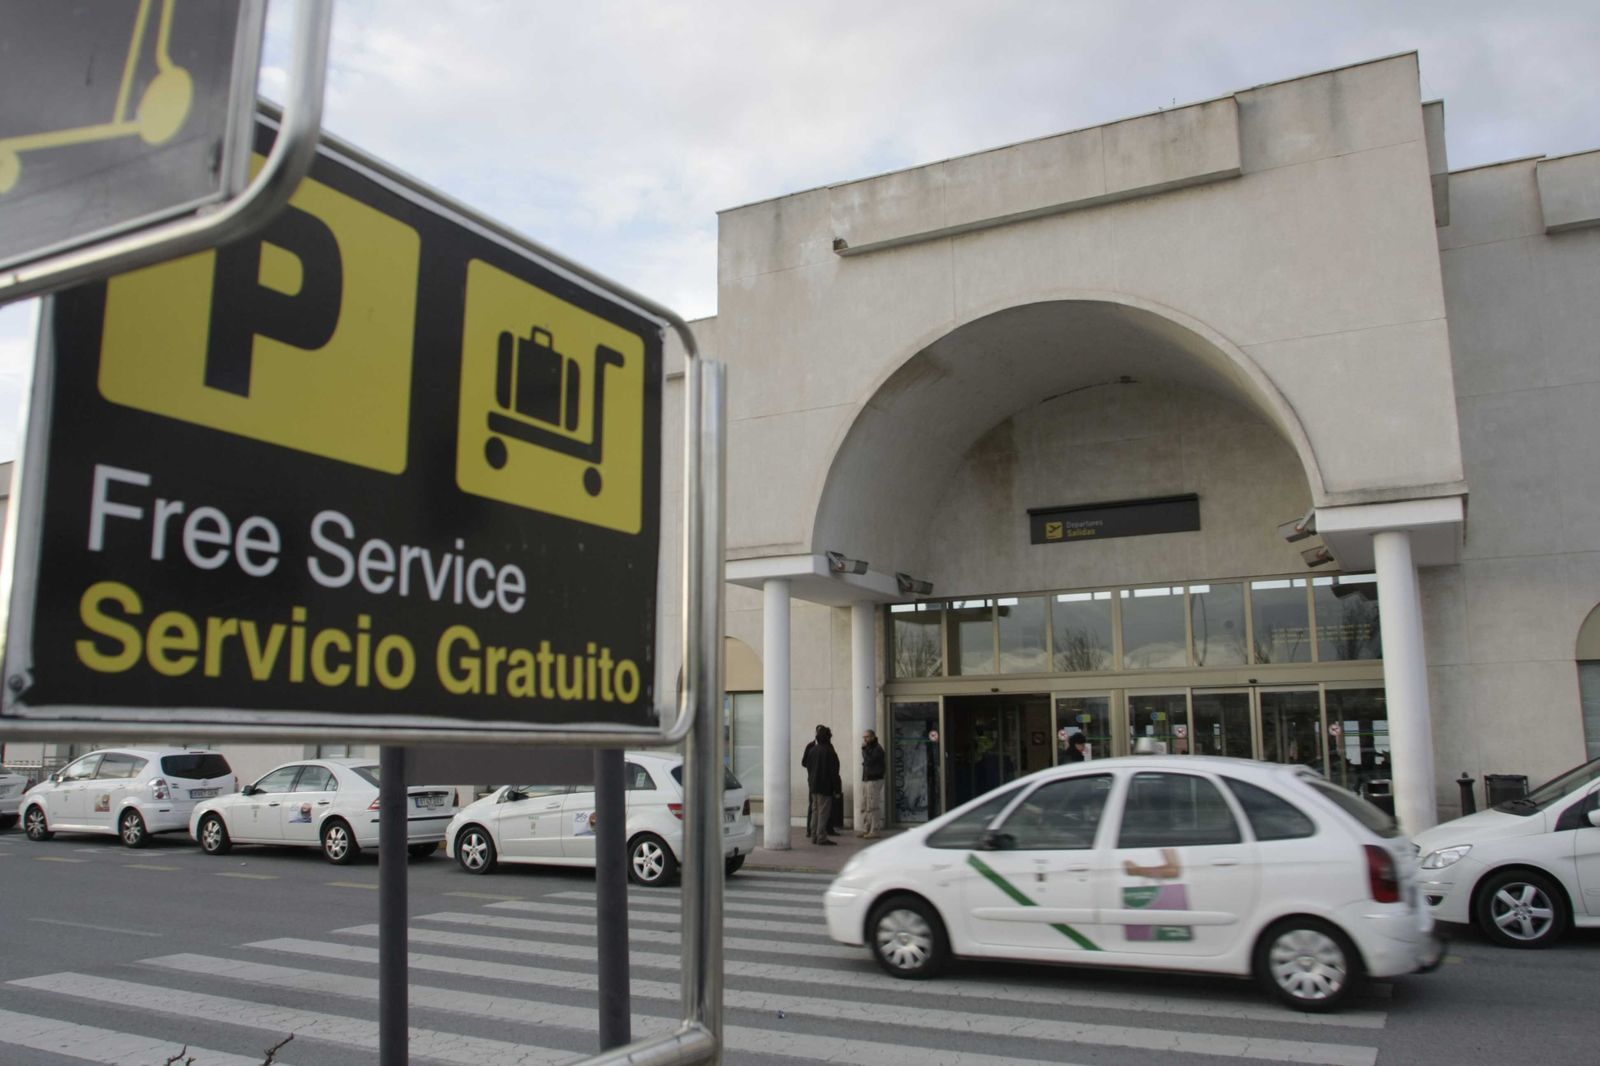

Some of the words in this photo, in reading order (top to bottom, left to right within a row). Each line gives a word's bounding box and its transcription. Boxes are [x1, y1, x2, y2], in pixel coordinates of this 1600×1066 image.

[203, 202, 344, 399] P
[88, 464, 281, 577] Free
[307, 510, 526, 613] Service
[1066, 519, 1103, 529] Departures
[1066, 528, 1096, 537] Salidas
[75, 581, 414, 691] Servicio
[436, 625, 640, 704] Gratuito
